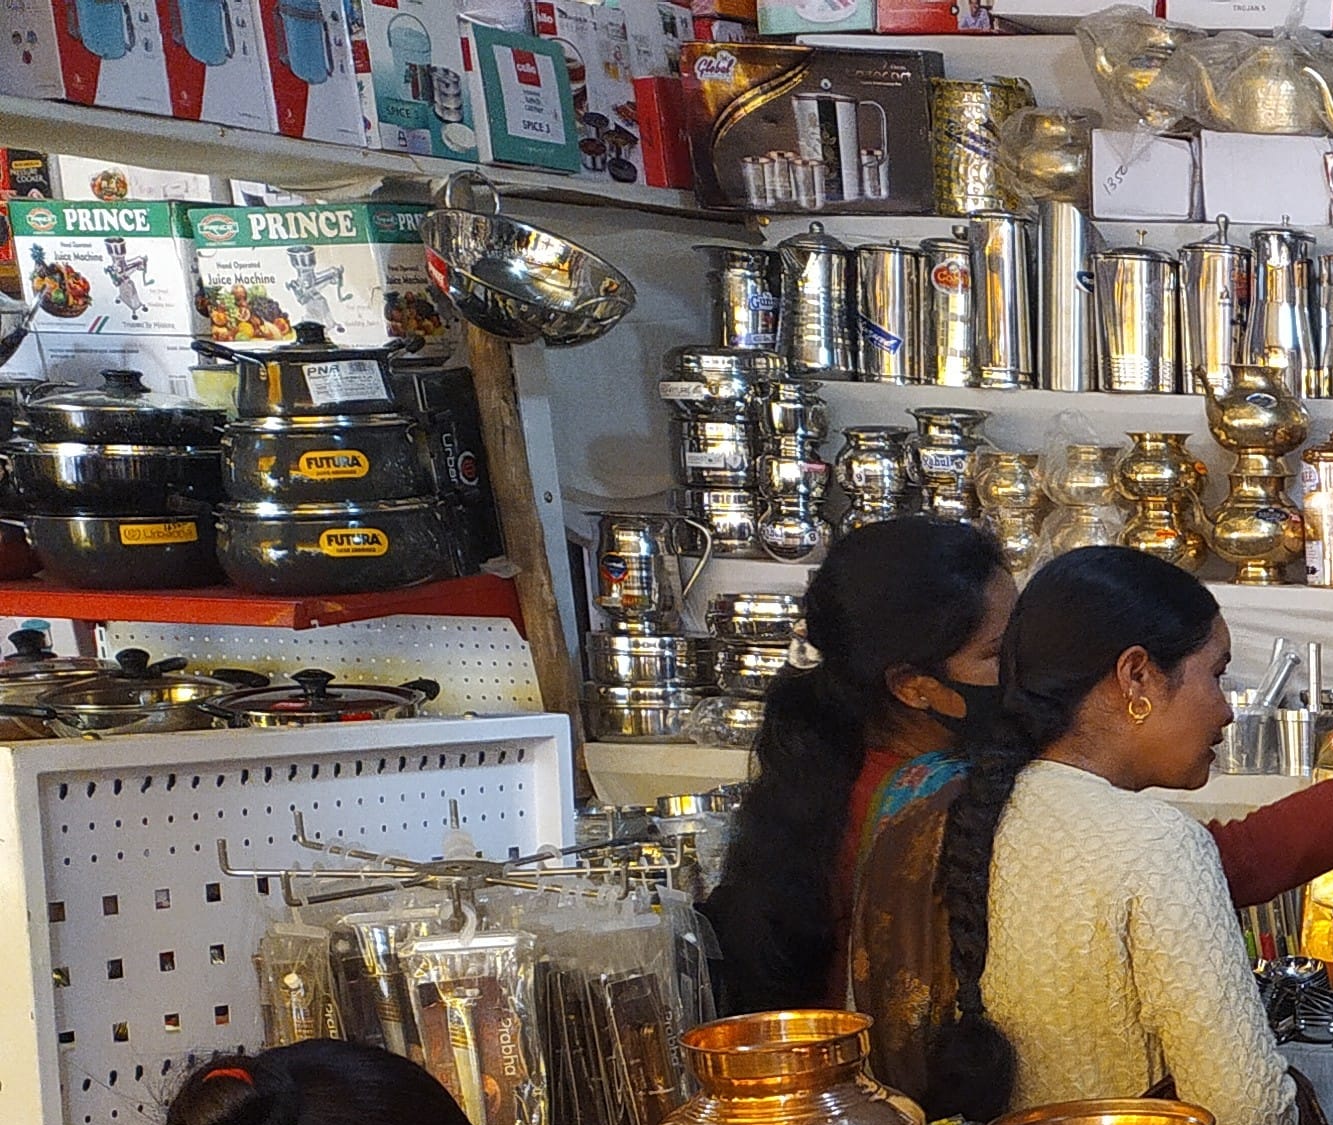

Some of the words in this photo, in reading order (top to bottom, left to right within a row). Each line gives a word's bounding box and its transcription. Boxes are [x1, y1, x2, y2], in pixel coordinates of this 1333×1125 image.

[522, 119, 542, 131] SPICE
[63, 208, 150, 232] PRINCE
[247, 210, 357, 241] PRINCE
[396, 212, 423, 232] PRI
[73, 251, 104, 262] Machine
[208, 274, 232, 285] Juice
[234, 274, 276, 285] Machine
[305, 454, 362, 471] FUTURA
[326, 532, 382, 549] FUTURA
[500, 1017, 518, 1076] Prabha
